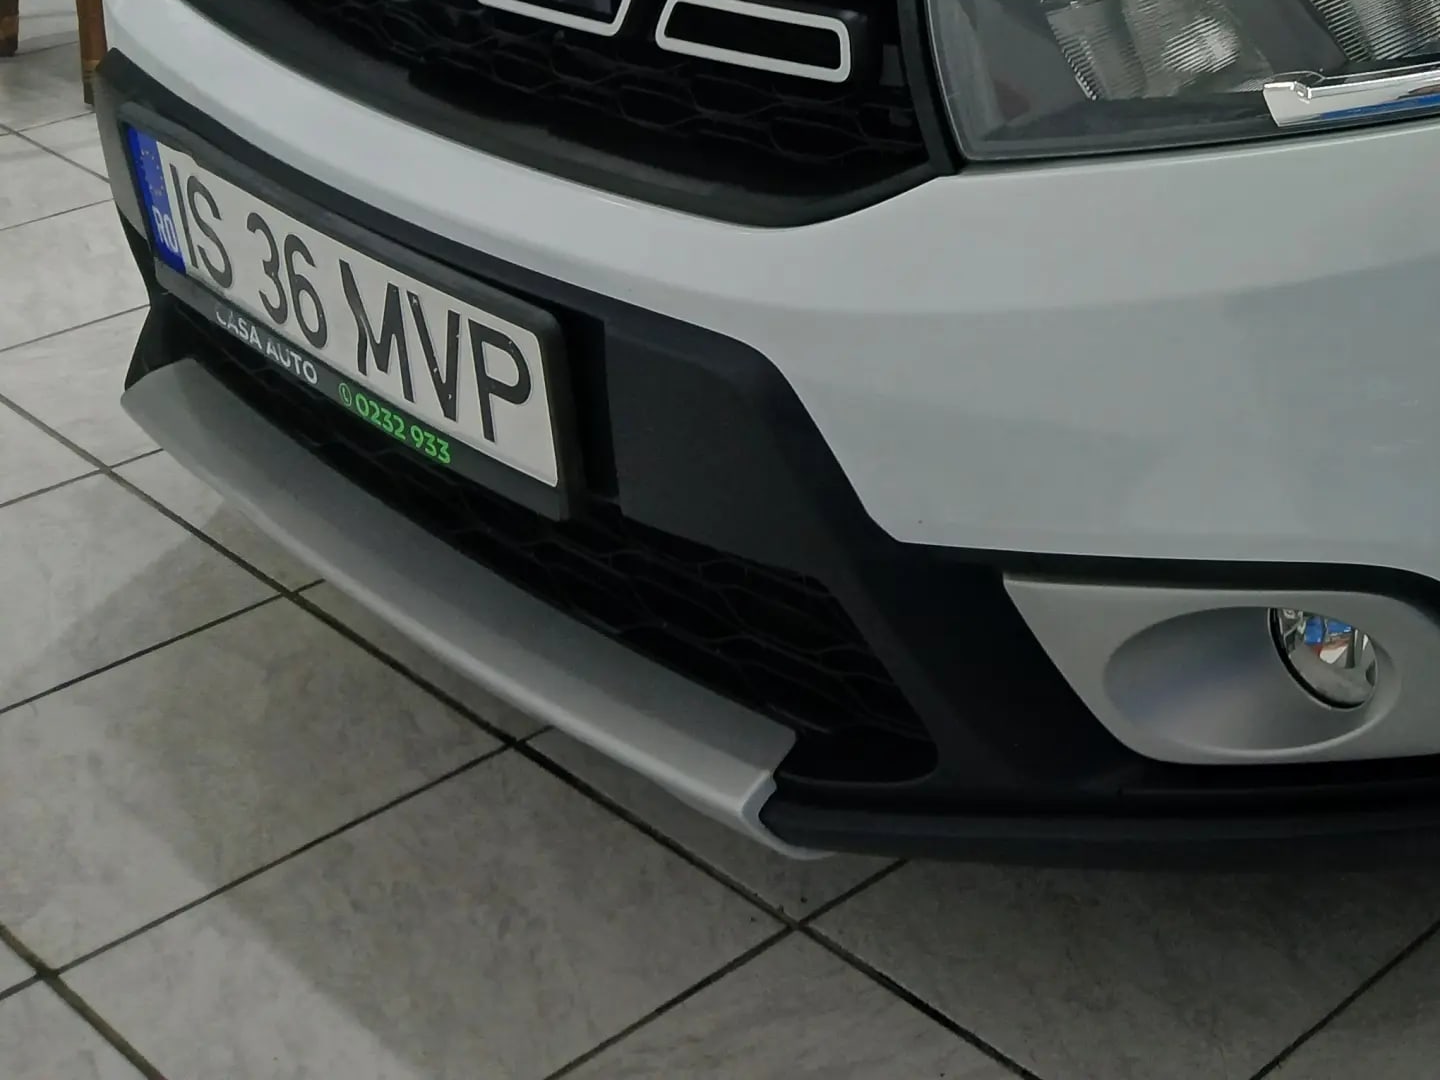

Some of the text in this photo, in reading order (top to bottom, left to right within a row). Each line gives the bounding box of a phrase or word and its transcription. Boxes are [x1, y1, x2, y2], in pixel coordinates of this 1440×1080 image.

[152, 205, 179, 253] RO
[169, 163, 532, 443] IS 36 MVP
[266, 341, 318, 384] AUTO
[355, 393, 451, 463] 0232 933
